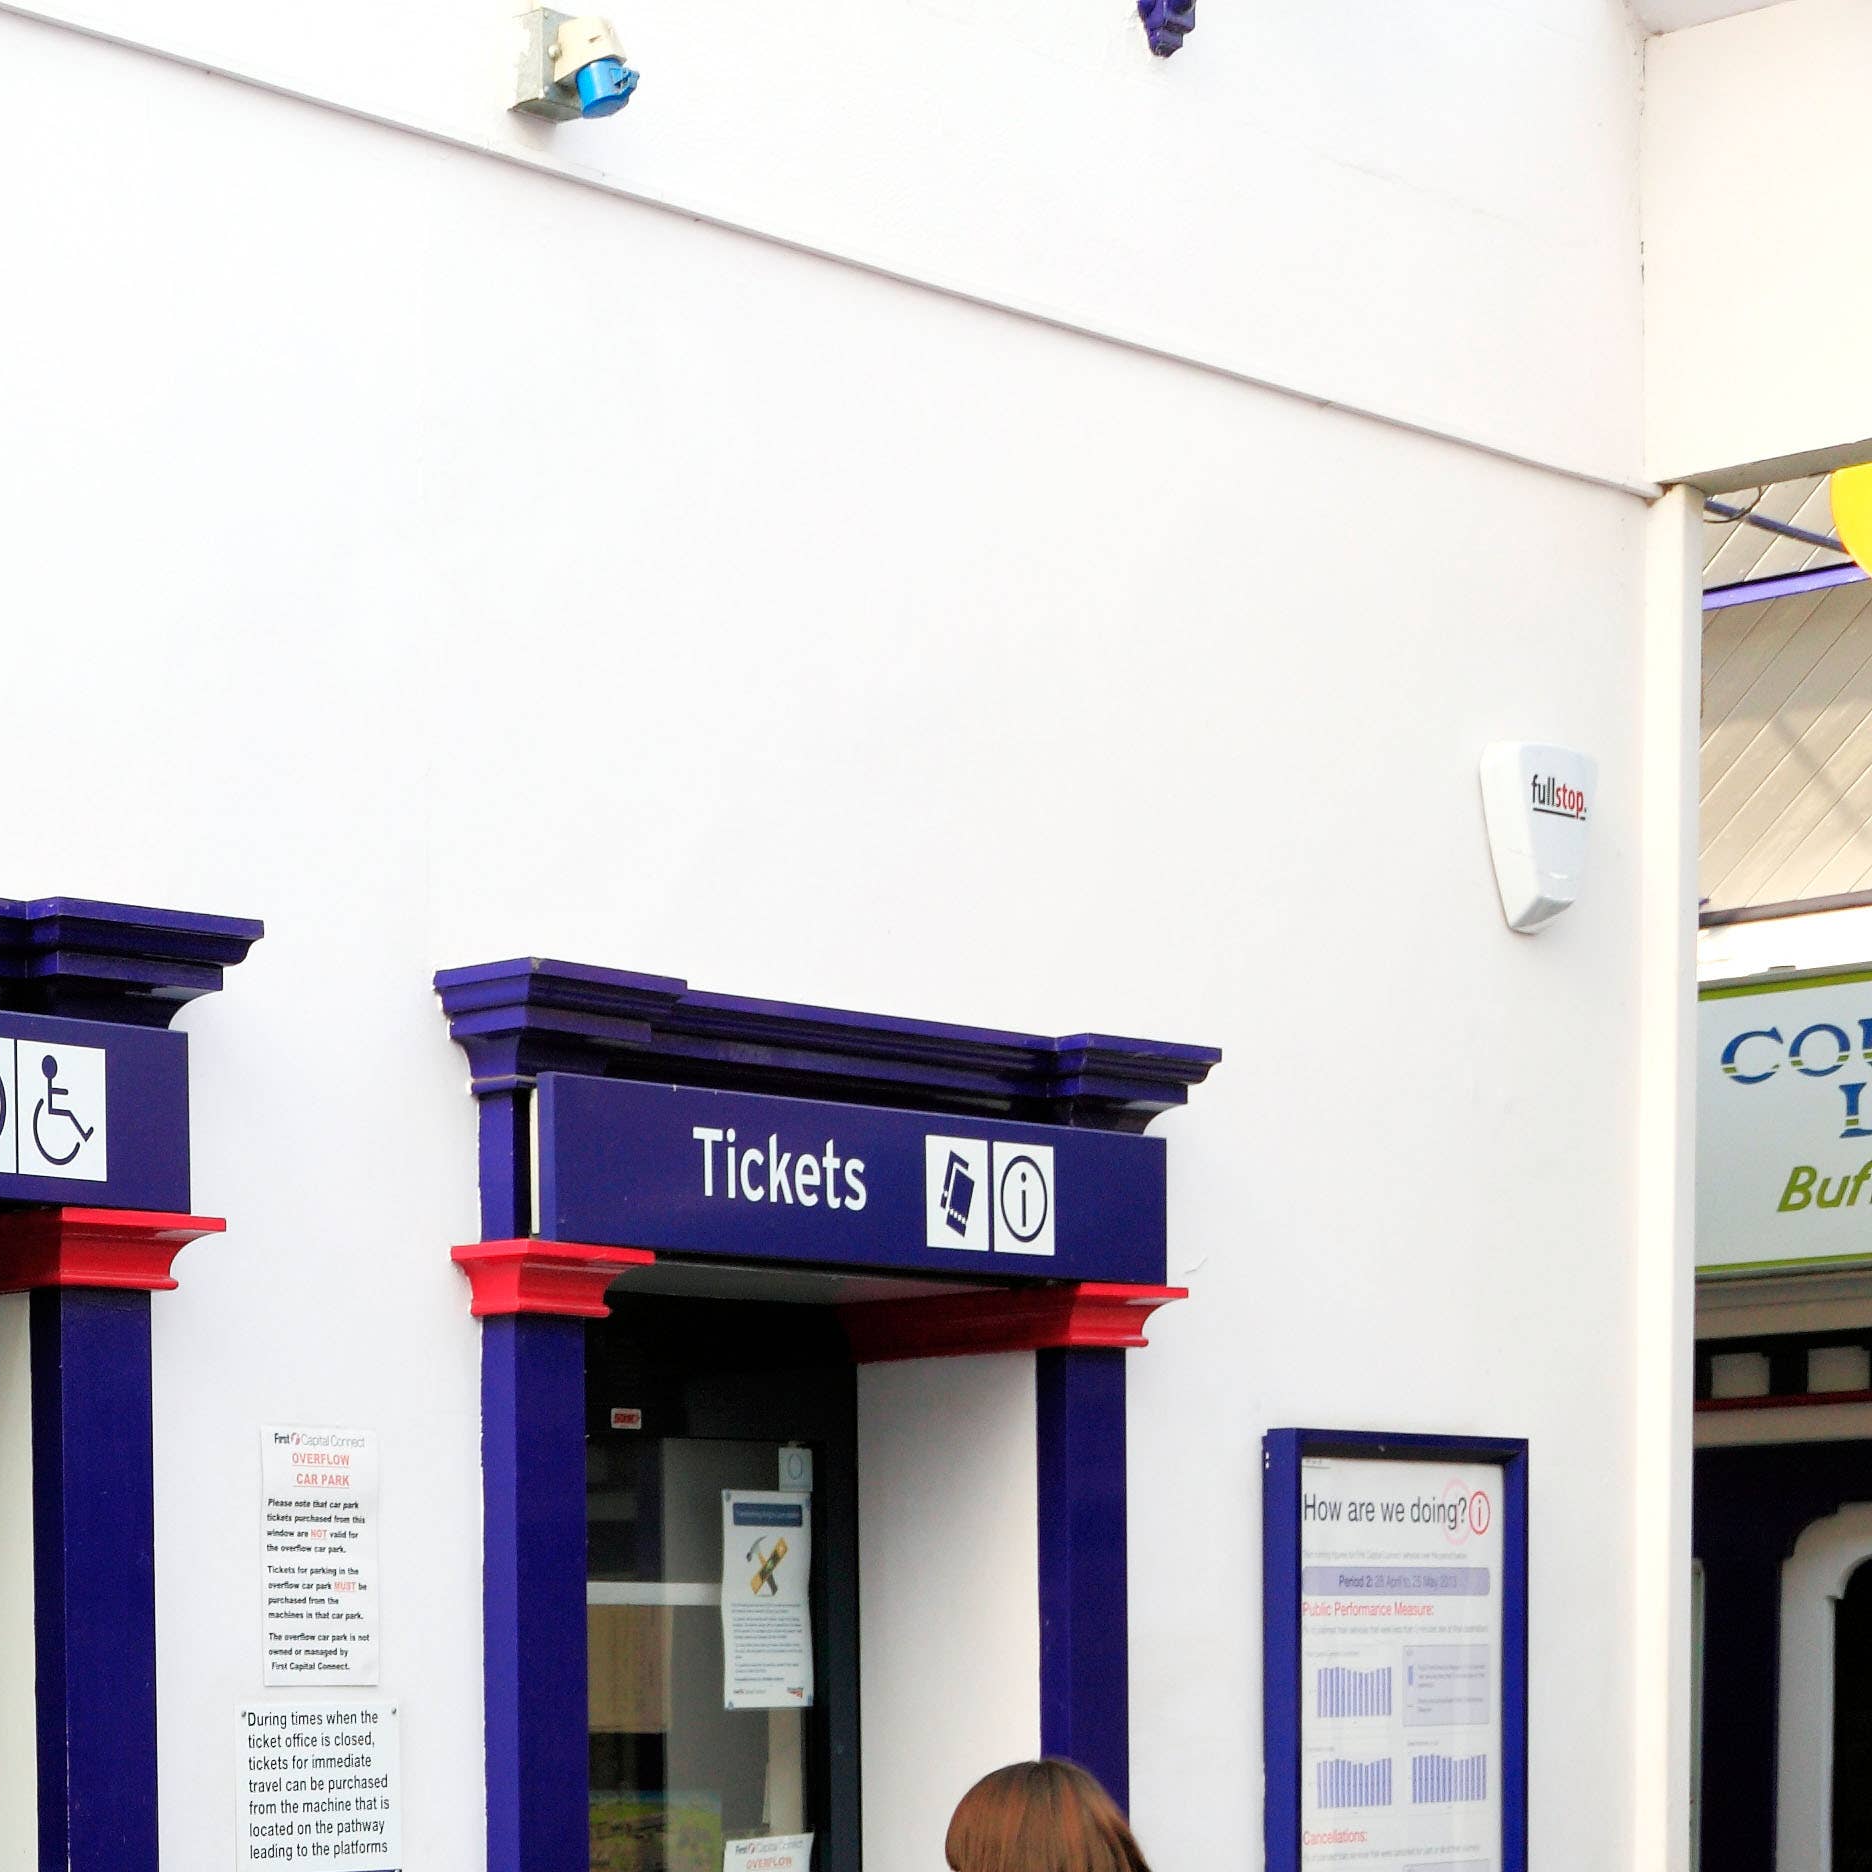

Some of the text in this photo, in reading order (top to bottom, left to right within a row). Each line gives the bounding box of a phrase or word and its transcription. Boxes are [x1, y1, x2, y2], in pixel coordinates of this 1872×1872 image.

[1721, 1018, 1872, 1085] CO
[693, 1126, 867, 1212] Tickets
[1777, 1159, 1872, 1212] Buf
[275, 1433, 365, 1447] First Capital Connect
[292, 1453, 350, 1466] OVERFLOW
[297, 1474, 349, 1486] CAR PARK
[268, 1499, 292, 1507] Please
[313, 1500, 327, 1508] that
[343, 1500, 359, 1510] park
[1303, 1494, 1467, 1530] How are we doing?
[267, 1514, 365, 1524] tickets purchased from this
[267, 1529, 294, 1537] window
[311, 1530, 327, 1538] NOT
[330, 1530, 346, 1538] valid
[281, 1544, 311, 1552] overflow
[329, 1545, 346, 1554] park.
[1303, 1602, 1331, 1616] Public
[1334, 1601, 1392, 1617] Performance
[248, 1711, 378, 1729] During times when the
[249, 1732, 374, 1748] ticket office is closed,
[249, 1754, 371, 1770] tickets for immediate
[249, 1774, 388, 1793] travel can be purchased
[249, 1796, 389, 1815] from the machine that is
[250, 1820, 384, 1837] located on the pathway
[250, 1841, 388, 1860] leading to the platforms
